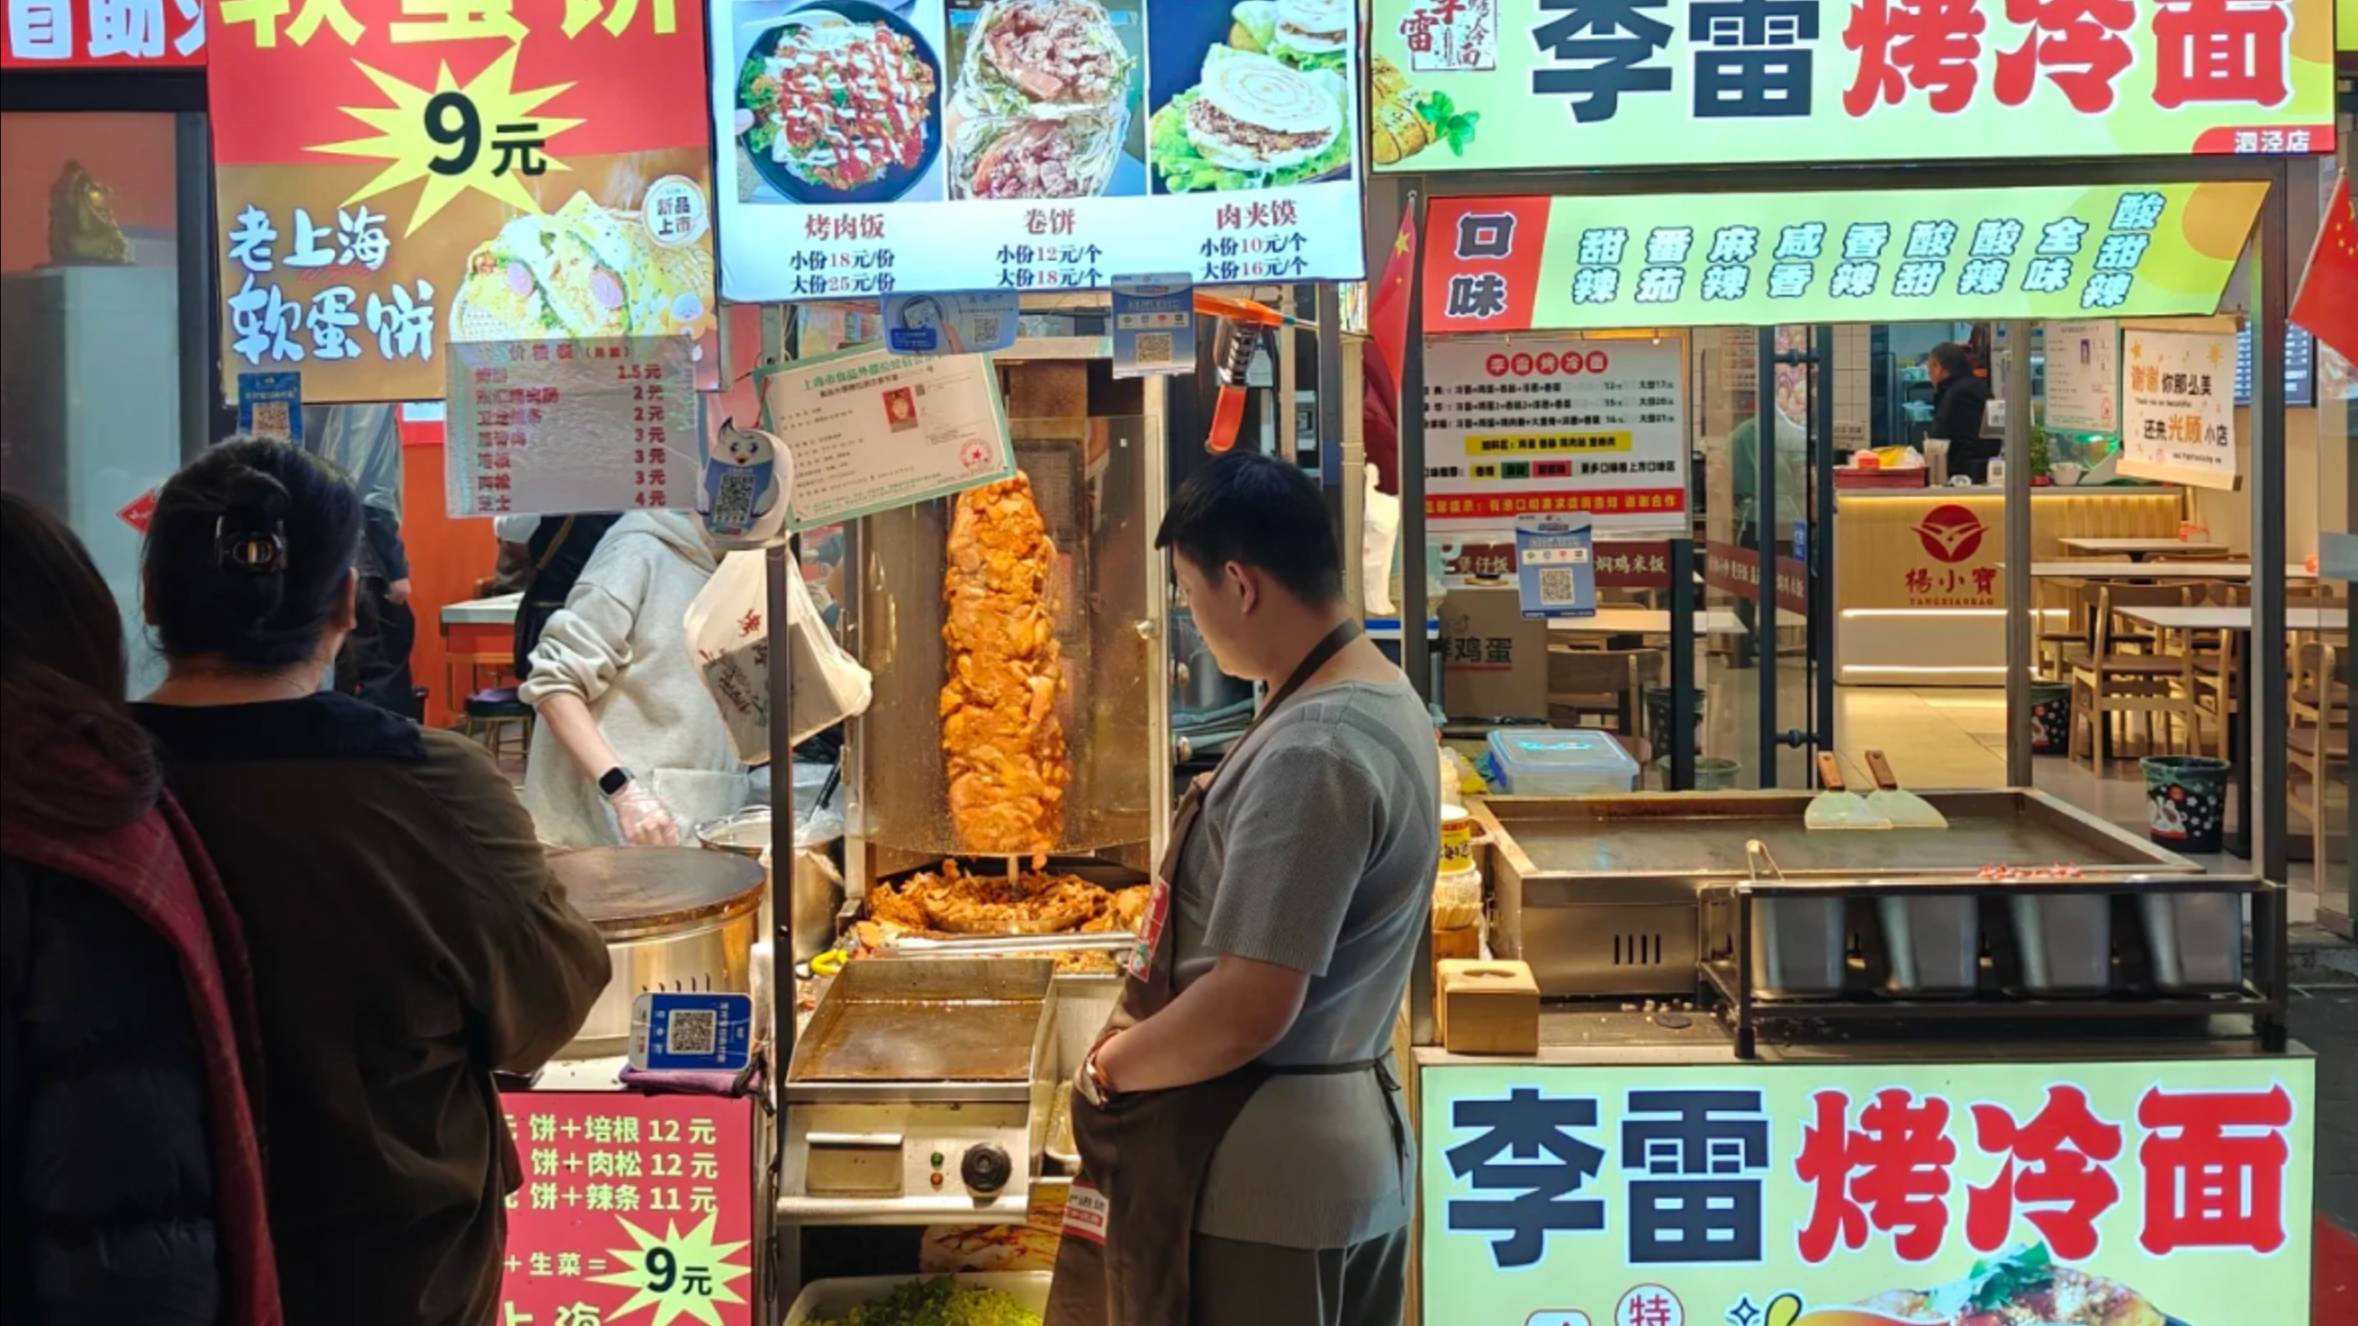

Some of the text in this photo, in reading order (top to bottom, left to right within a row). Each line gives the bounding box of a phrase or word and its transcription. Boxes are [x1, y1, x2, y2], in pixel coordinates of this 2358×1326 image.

[1532, 0, 2289, 124] 李雷烤冷面
[2234, 129, 2311, 153] 泗泾店
[228, 204, 392, 271] 老上海
[658, 216, 691, 236] 上市
[804, 213, 885, 240] 烤肉饭
[1025, 208, 1075, 235] 卷饼
[1216, 200, 1297, 230] 肉夹馍
[789, 249, 895, 271] 小份18元/份
[996, 243, 1103, 265] 小份12元/个
[1199, 231, 1307, 257] 小份10元/个
[1202, 255, 1308, 281] 大份16元/个
[1445, 212, 1517, 319] 口味
[1635, 226, 1693, 303] 番茄
[1700, 225, 1760, 301] 麻辣
[1829, 221, 1891, 297] 香辣
[1892, 219, 1959, 297] 酸甜
[1957, 219, 2024, 295] 酸辣
[2021, 216, 2089, 293] 全味
[790, 272, 896, 295] 大份25元/份
[998, 267, 1103, 288] 大份18元/个
[228, 274, 435, 366] 软蛋饼
[1444, 1083, 2293, 1267] 李雷烤冷面
